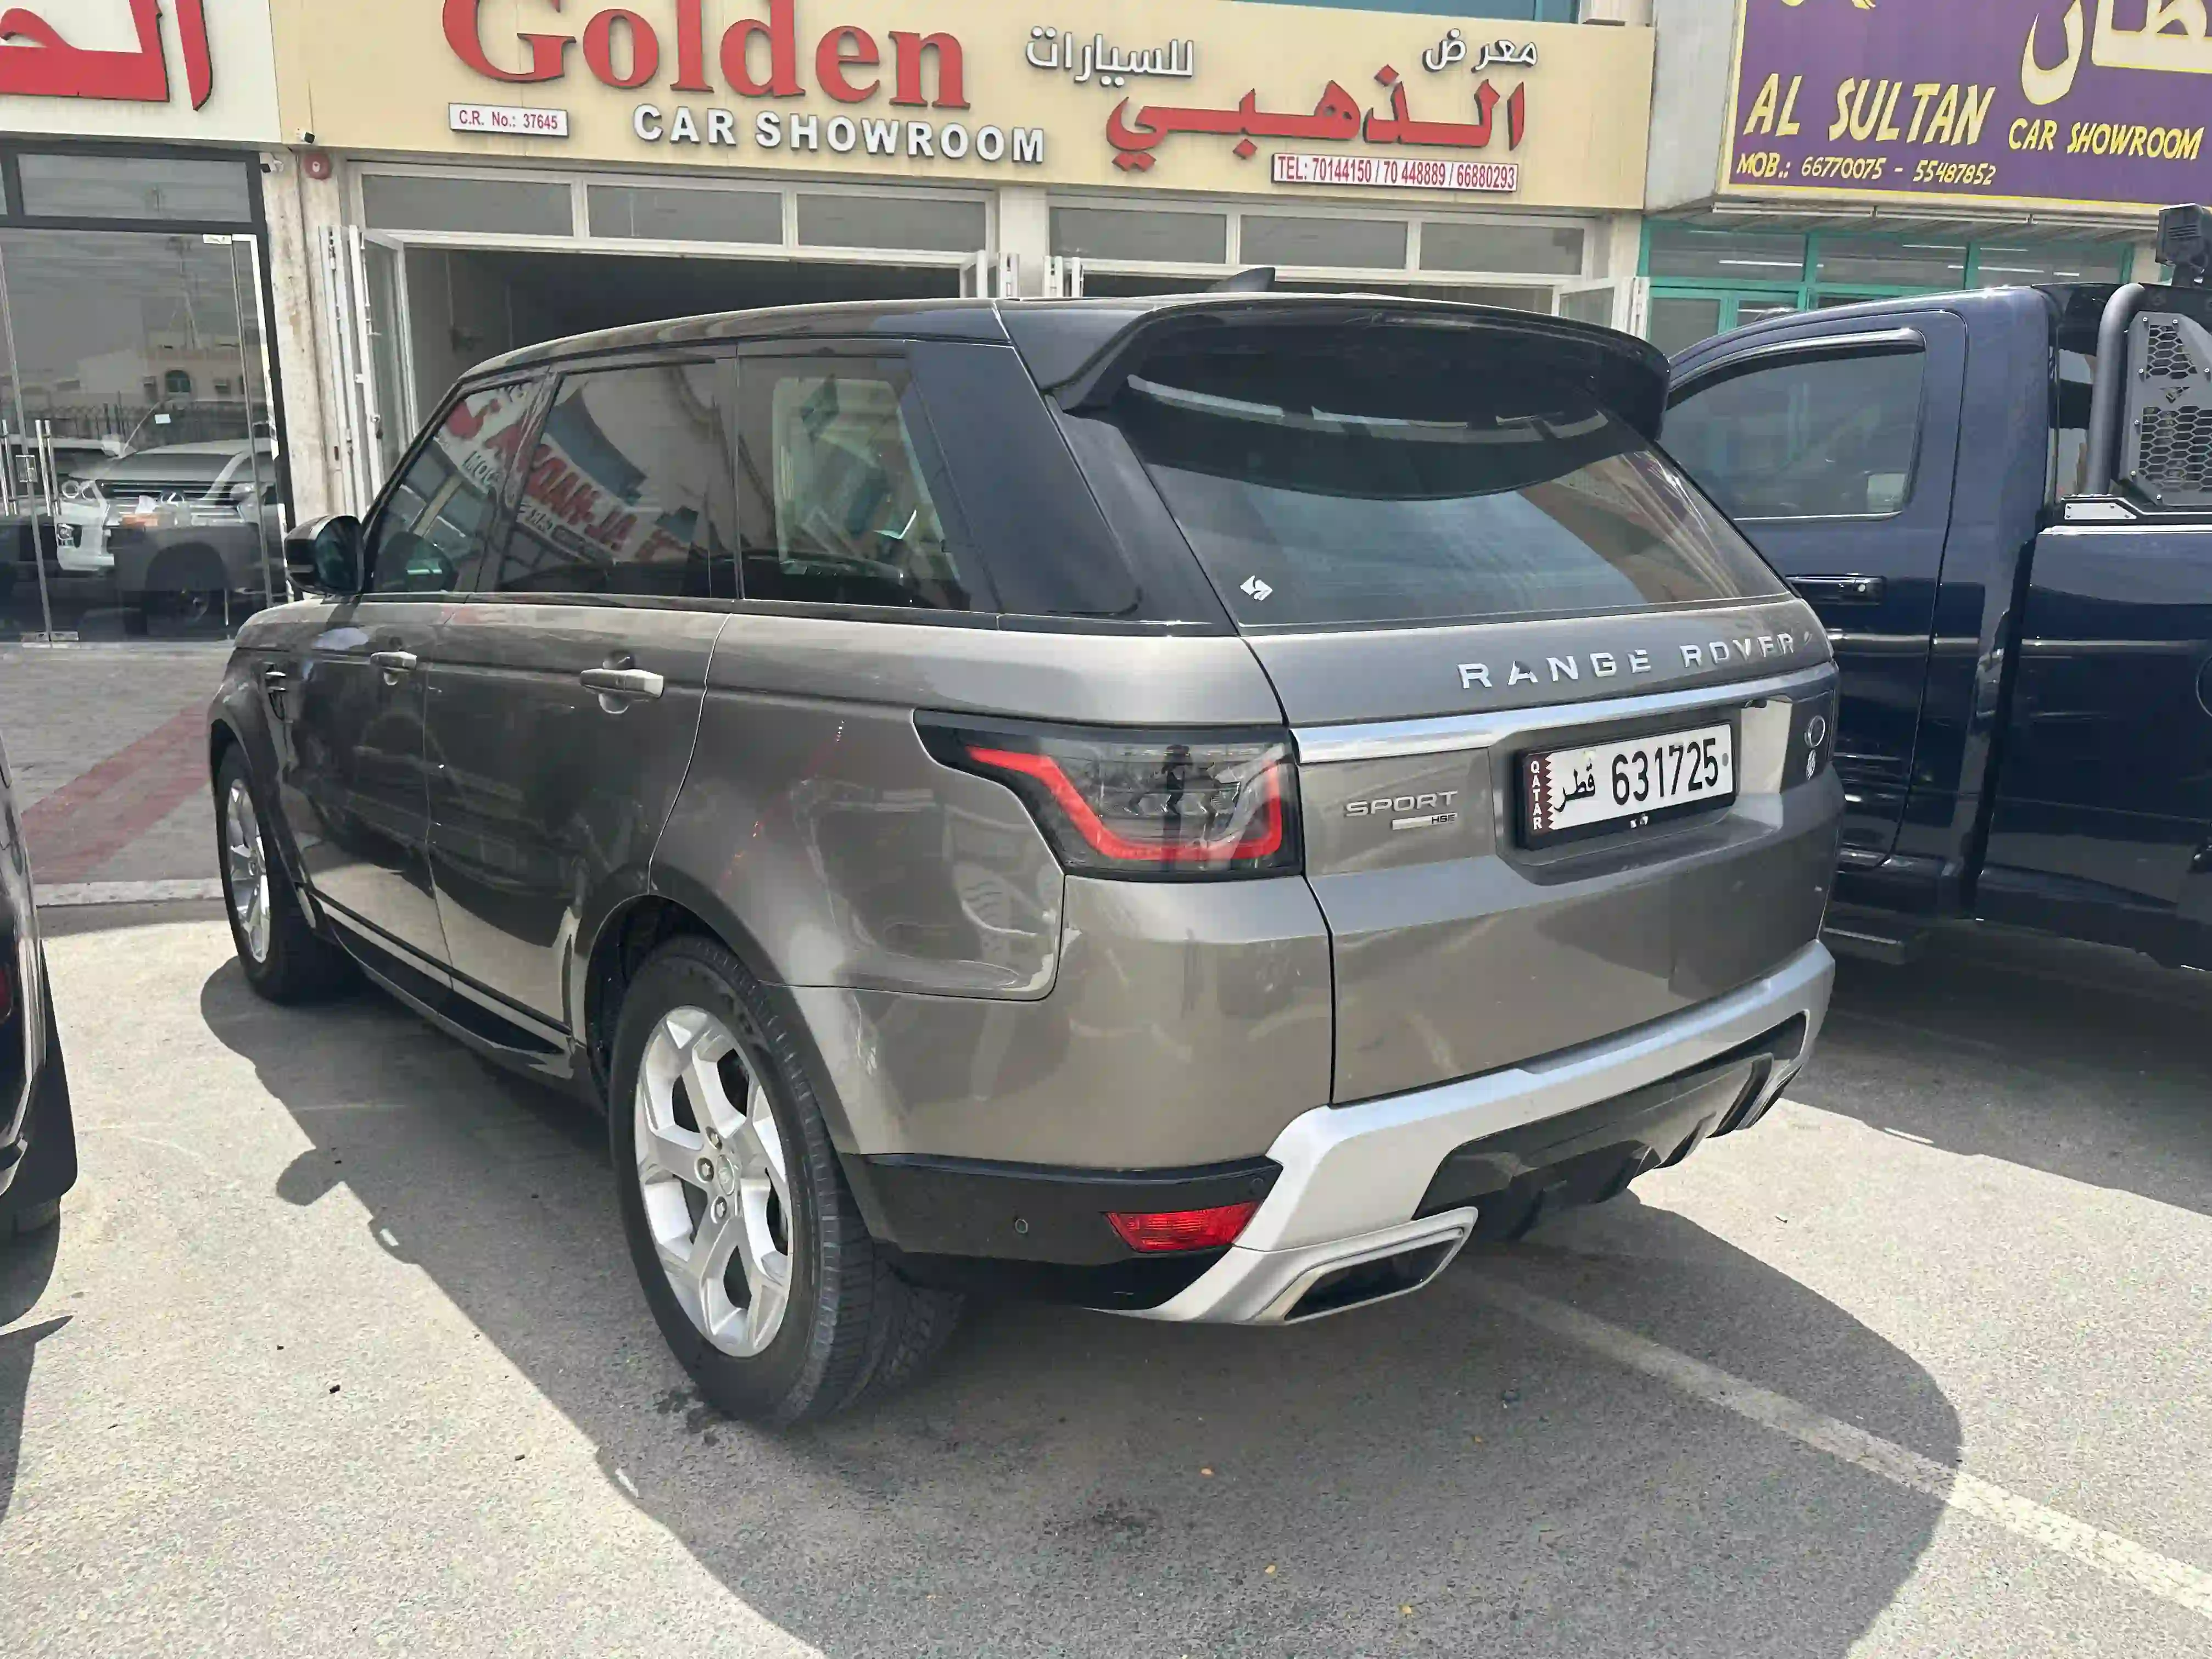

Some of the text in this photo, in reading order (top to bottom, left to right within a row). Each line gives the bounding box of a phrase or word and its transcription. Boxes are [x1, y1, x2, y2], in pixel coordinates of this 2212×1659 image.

[442, 0, 971, 110] Golden
[1025, 26, 1195, 87] للسيارات
[1422, 27, 1538, 73] معرض
[459, 110, 558, 130] C.R. No.: 37645
[633, 103, 1044, 164] CAR SHOWROOM
[1105, 64, 1525, 171] الذهبي
[1744, 72, 1996, 146] AL SULTAN
[2008, 118, 2205, 161] CAR SHOWROOM
[1278, 155, 1308, 181] TEL:
[1312, 158, 1371, 183] 70144150
[1383, 160, 1398, 183] 70
[1401, 161, 1445, 186] 448889
[1457, 164, 1515, 189] 66880293
[1801, 155, 1887, 180] 66770075
[1913, 158, 1997, 186] 55487852
[1458, 633, 1794, 689] RANGE ROVER
[1530, 761, 1543, 830] QATAR
[1554, 761, 1595, 813] قطر
[1612, 737, 1719, 806] 631725
[1345, 790, 1458, 817] SPORT
